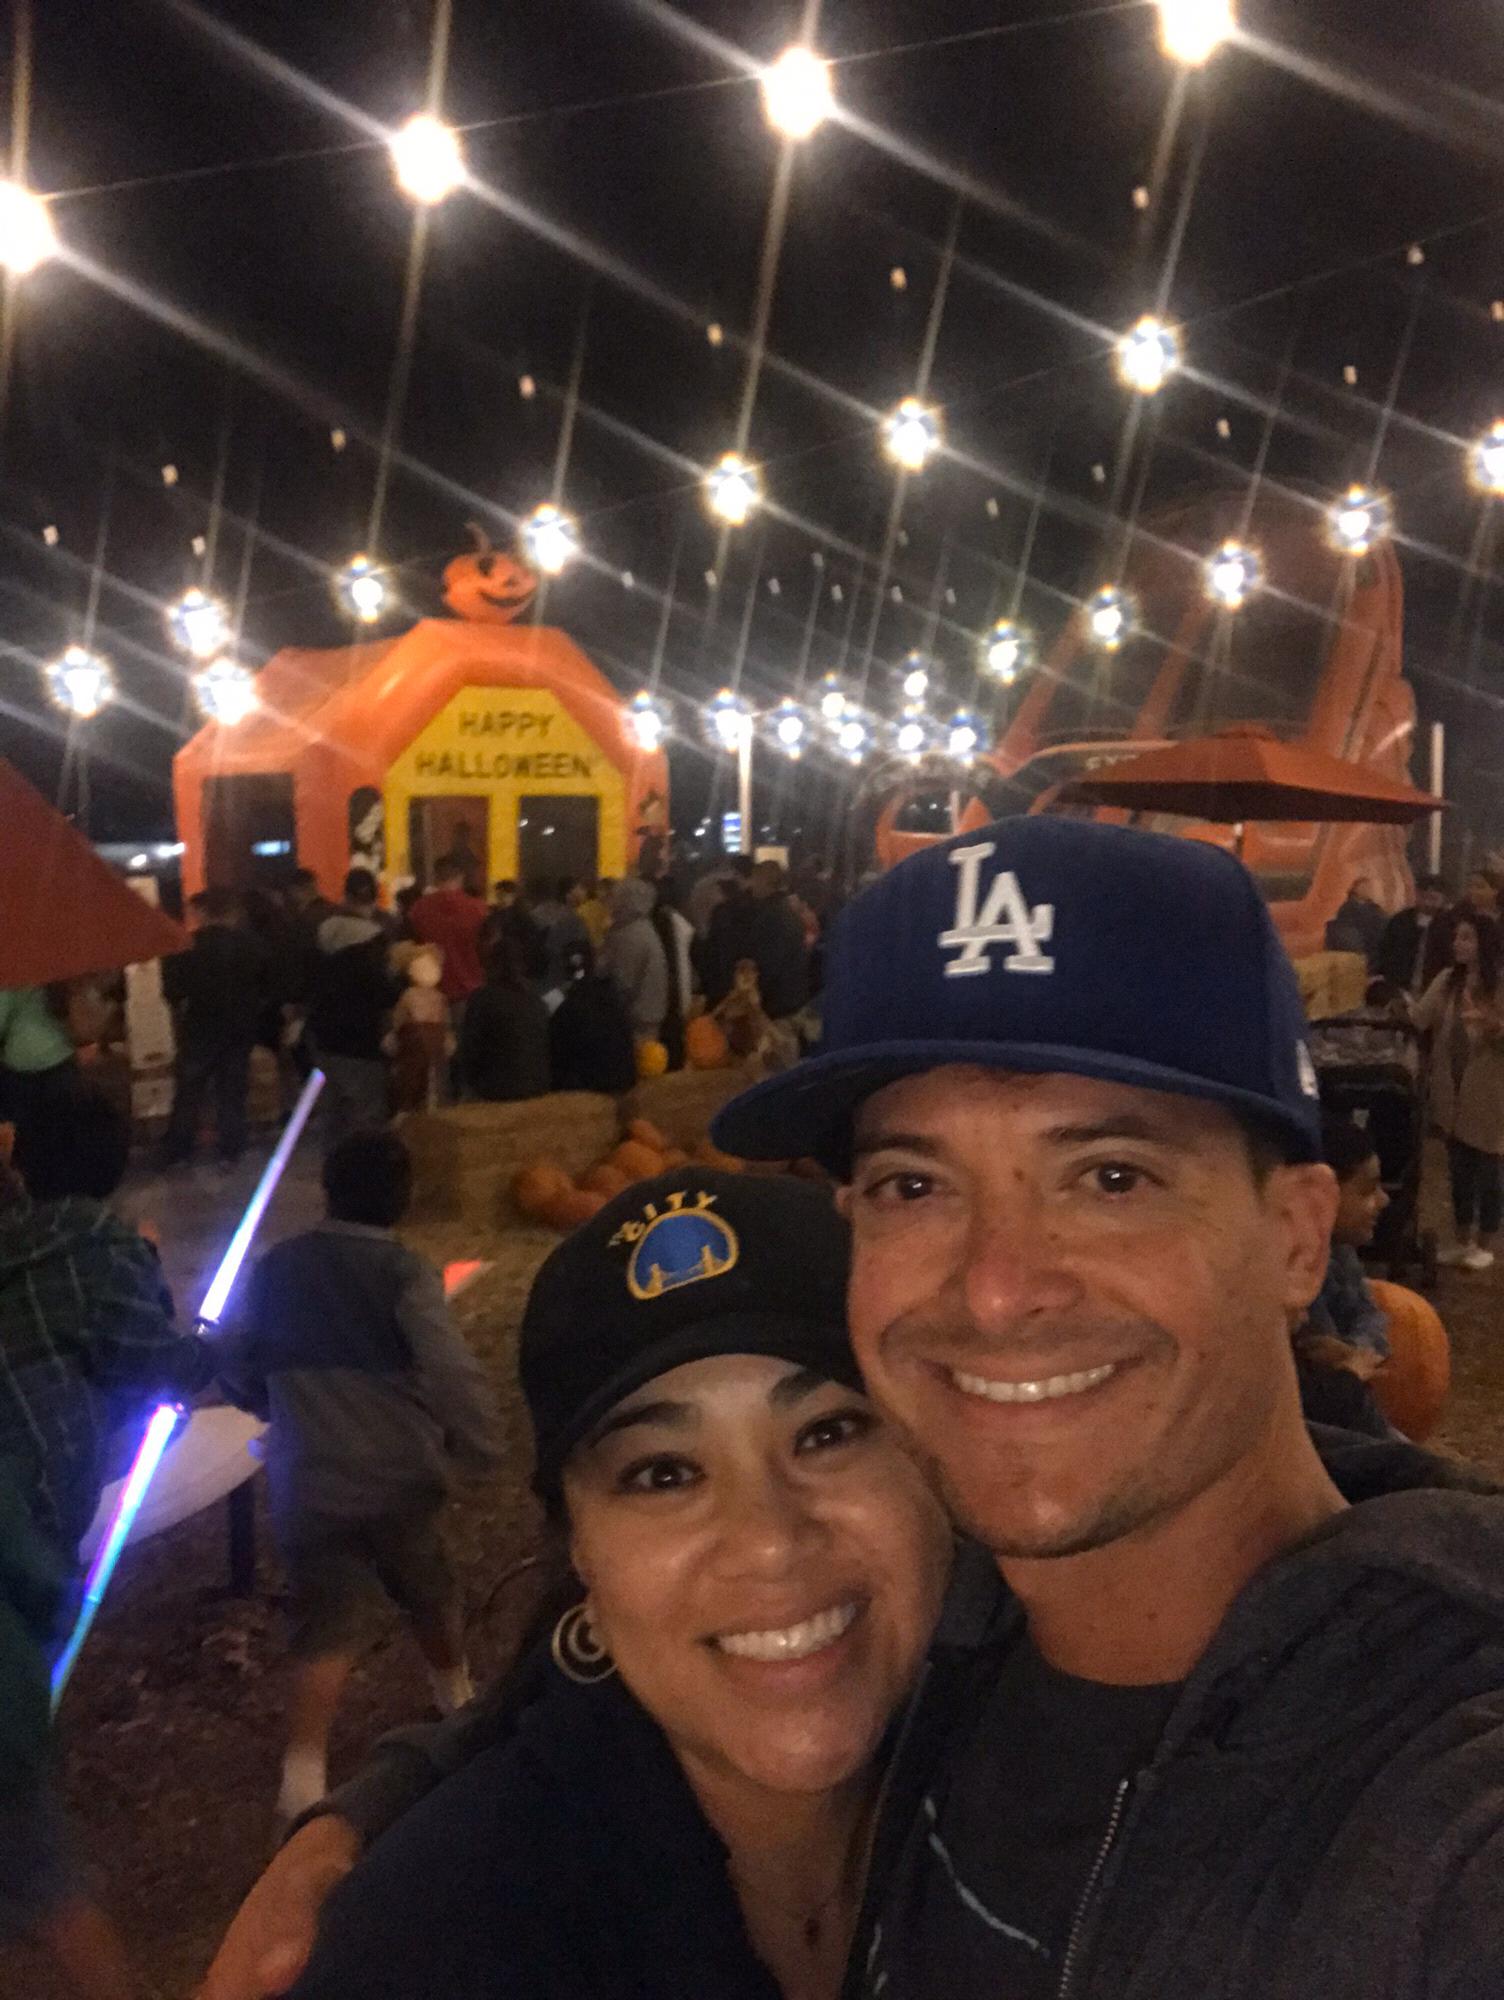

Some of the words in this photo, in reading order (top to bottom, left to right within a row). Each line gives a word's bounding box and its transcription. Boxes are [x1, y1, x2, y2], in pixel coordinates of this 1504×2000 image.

[458, 711, 555, 738] HAPPY
[415, 752, 592, 779] HALLOWEEN
[938, 842, 1054, 977] LA
